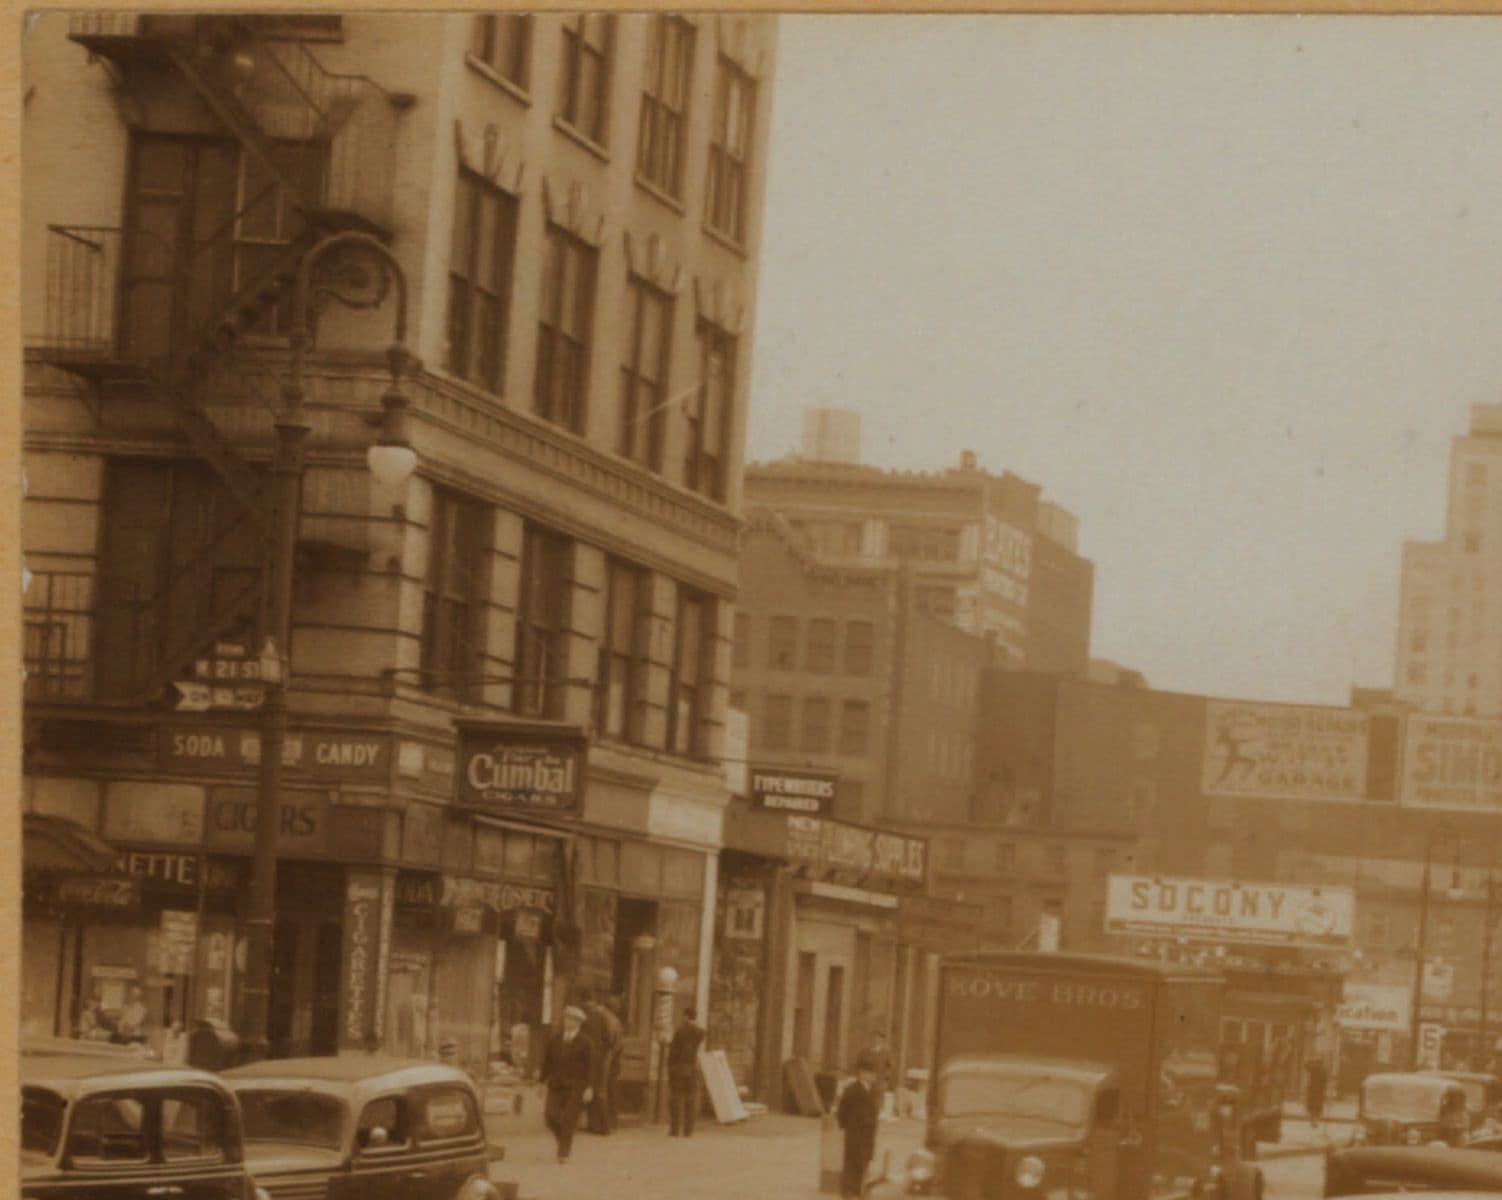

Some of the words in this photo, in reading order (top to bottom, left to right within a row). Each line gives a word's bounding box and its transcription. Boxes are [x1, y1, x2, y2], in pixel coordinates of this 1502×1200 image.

[173, 735, 227, 758] SODA
[316, 742, 380, 766] CANDY
[216, 801, 316, 839] CIGRS
[1130, 881, 1286, 919] SOCONY
